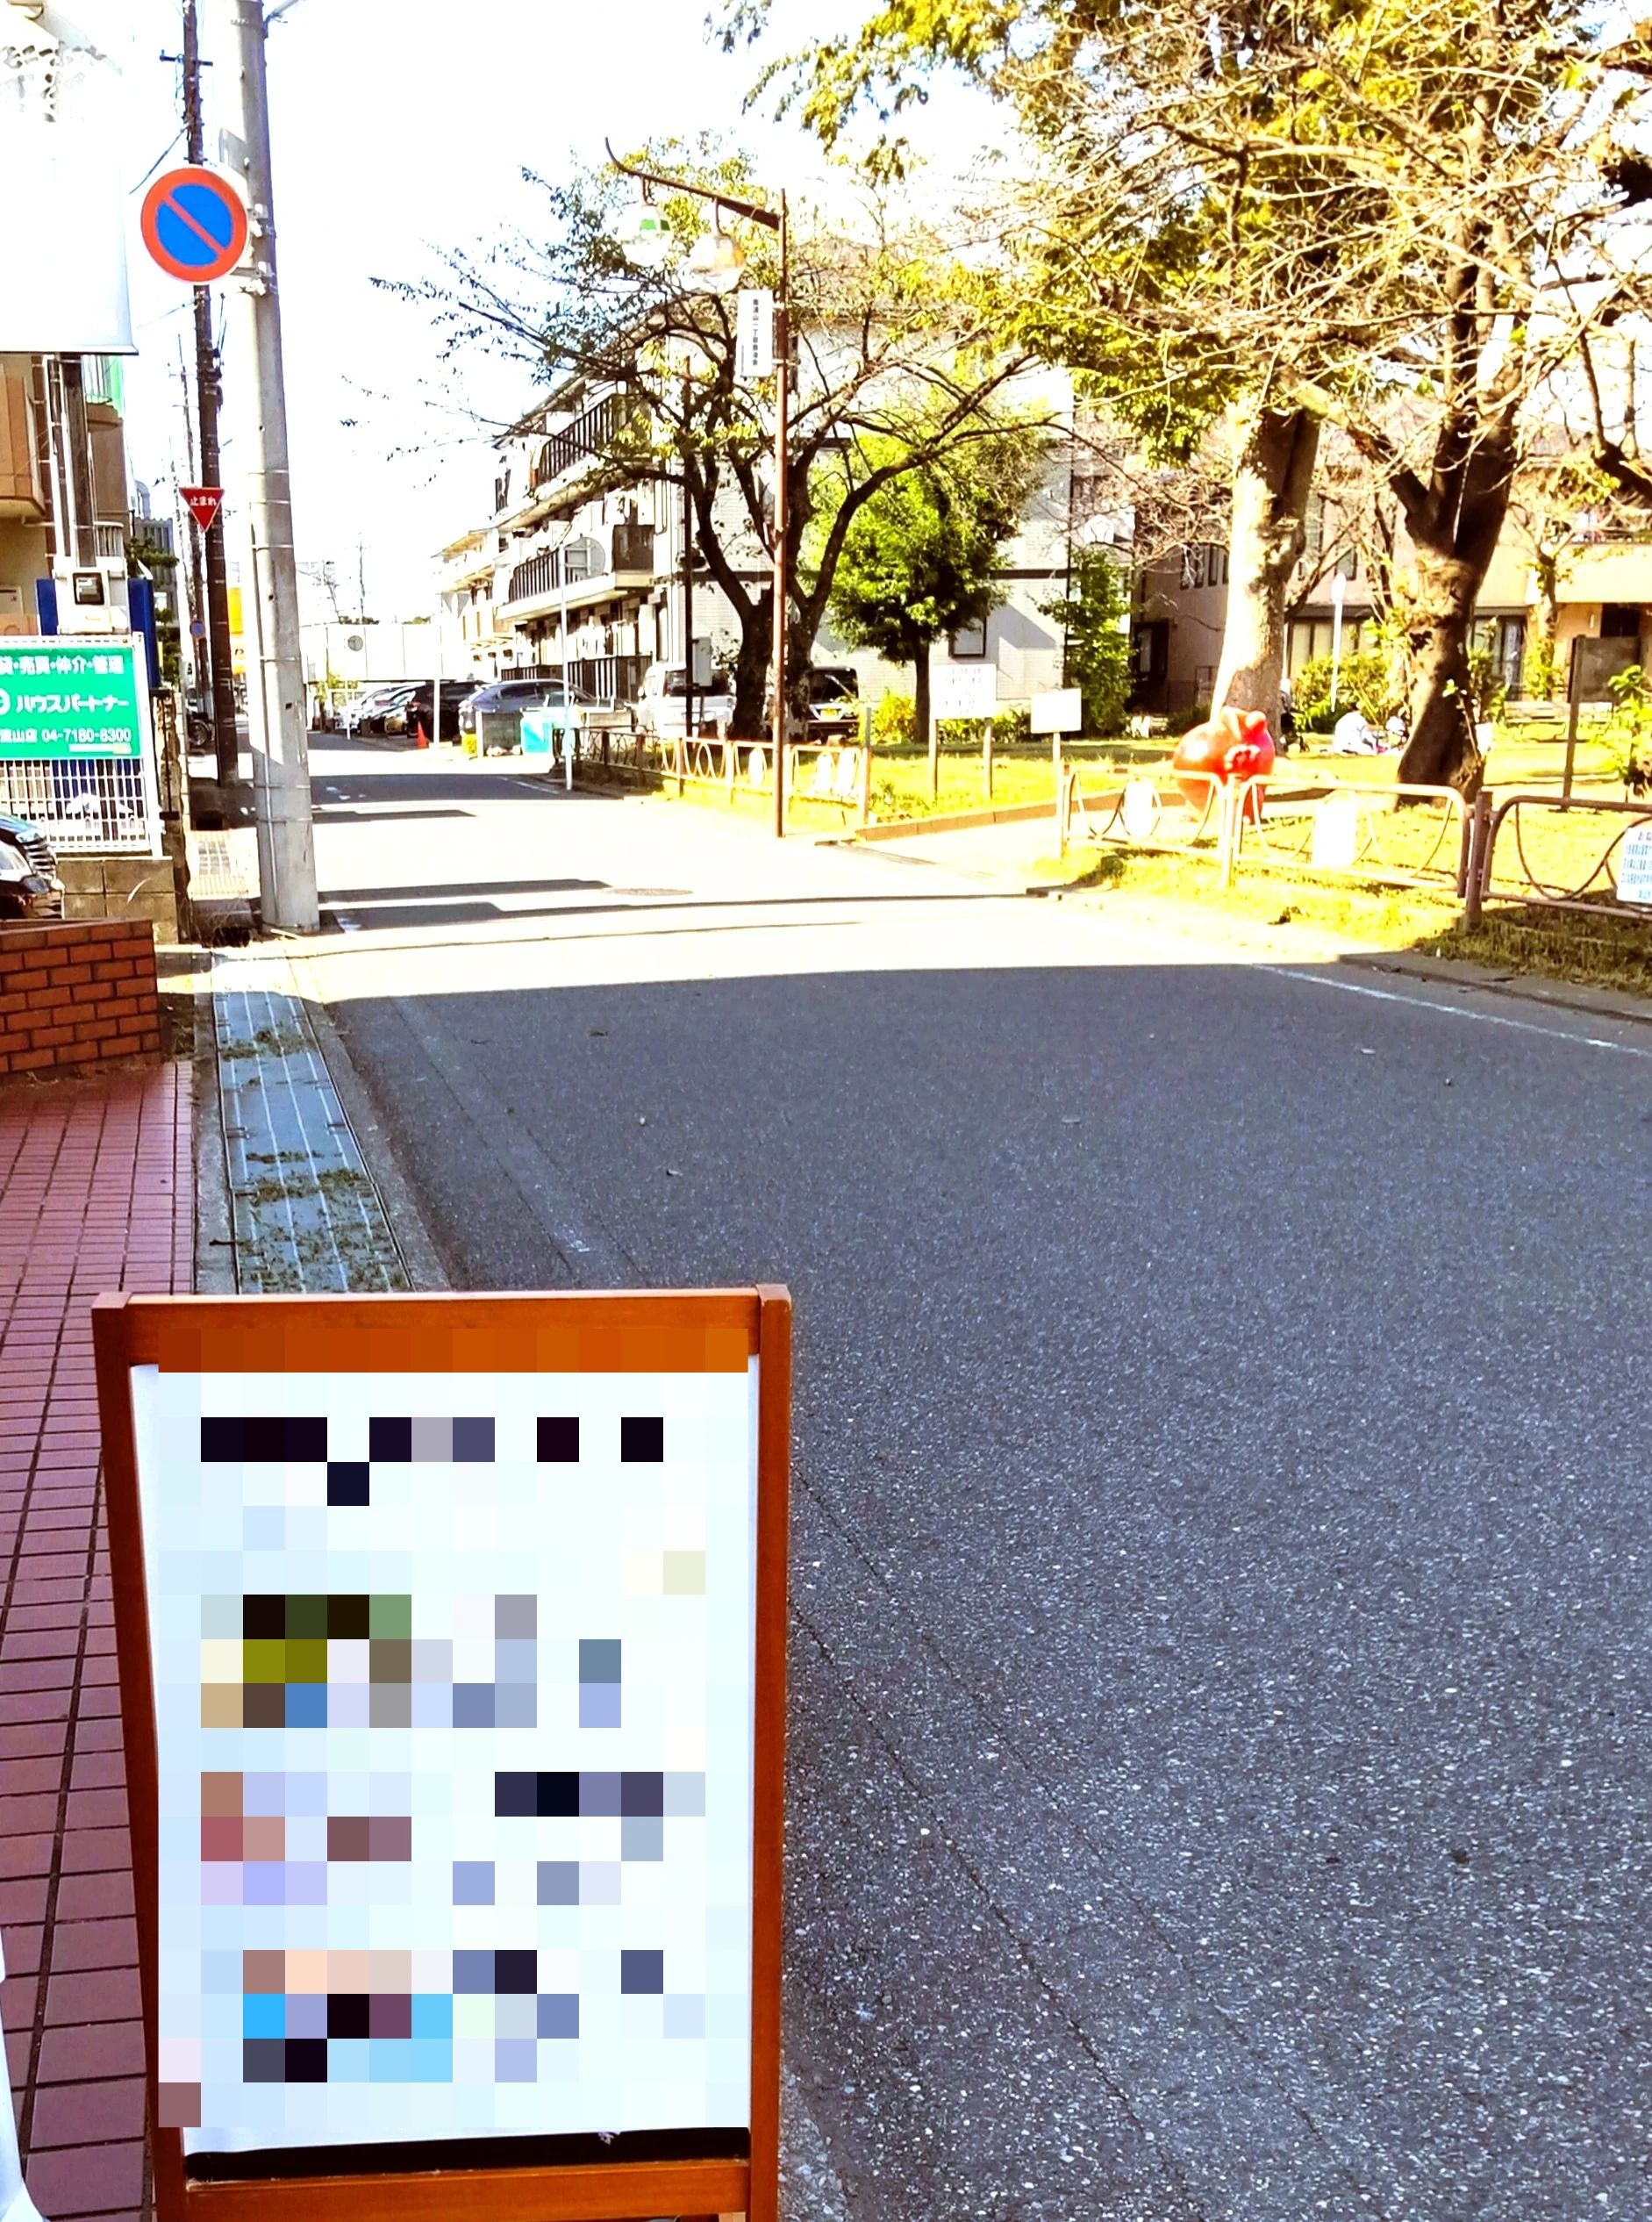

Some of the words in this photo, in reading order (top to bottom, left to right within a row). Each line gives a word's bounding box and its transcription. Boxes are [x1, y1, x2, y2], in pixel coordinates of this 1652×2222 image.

[190, 496, 217, 506] 止まれ
[16, 693, 129, 713] ハウスパートナー
